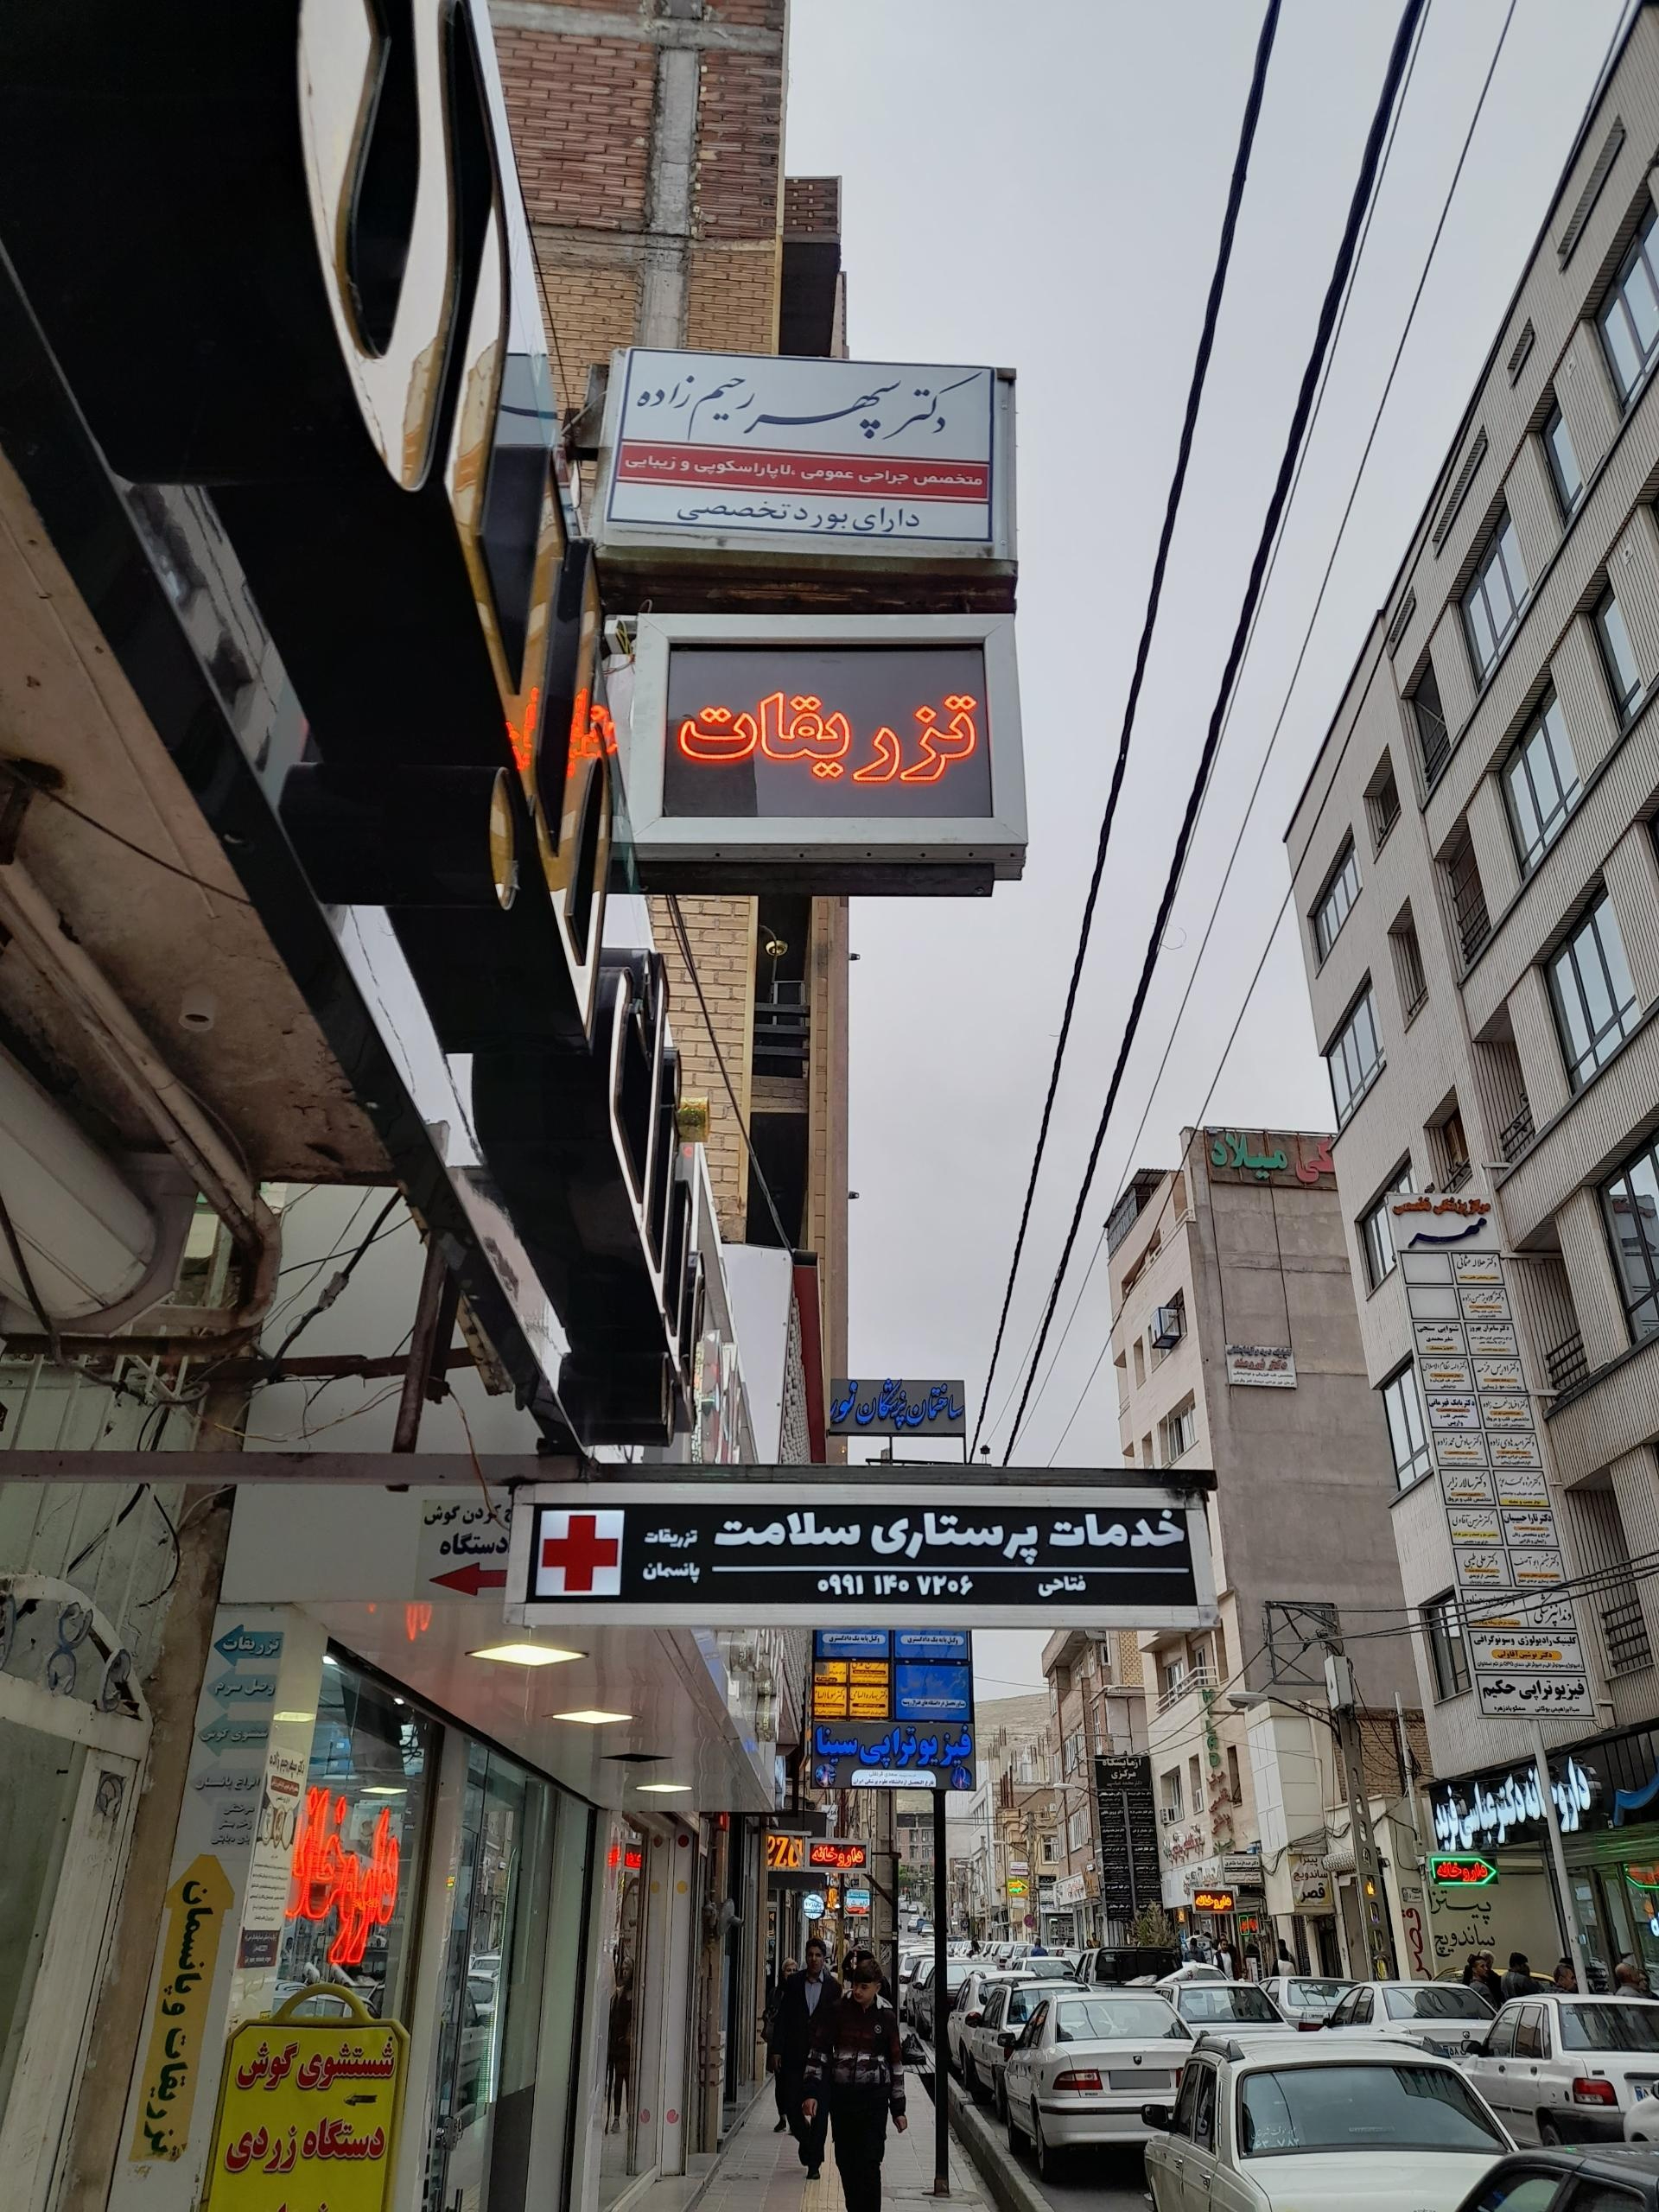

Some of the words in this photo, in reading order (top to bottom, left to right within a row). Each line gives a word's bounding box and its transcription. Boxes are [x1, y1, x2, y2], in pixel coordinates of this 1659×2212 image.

[636, 374, 696, 409] زاده
[743, 378, 902, 441] سپهر
[881, 372, 983, 441] دکتر
[624, 454, 677, 471] زیبایی
[679, 459, 691, 473] و
[800, 464, 855, 482] عمومی
[858, 468, 910, 486] جراحی
[912, 472, 984, 488] متخصص
[677, 499, 791, 522] تخصصی
[794, 504, 849, 531] بورد
[852, 506, 921, 533] دارای
[678, 691, 978, 783] تزریقات
[1211, 1133, 1288, 1180] میلاد
[1472, 1472, 1487, 1491] دکتر
[714, 1512, 861, 1548] سلامت
[1048, 1508, 1187, 1551] خدمات
[1539, 1514, 1553, 1524] دکتر
[644, 1529, 698, 1547] تزریقات
[872, 1512, 1039, 1565] پرستاری
[642, 1562, 700, 1582] پانسمان
[1038, 1574, 1087, 1598] فتاحی
[221, 1635, 281, 1656] تزریقات
[1553, 1636, 1576, 1647] کلینیک
[1482, 1679, 1516, 1700] حکیم
[1519, 1679, 1586, 1701] فیزیوتراپی
[815, 1725, 859, 1765] سینا
[859, 1724, 973, 1769] فیزیوتراپی
[1111, 1769, 1137, 1780] مرکزی
[811, 1846, 864, 1866] داروخانه
[1436, 1860, 1488, 1883] داروخانه
[1195, 1894, 1232, 1910] داروخانه
[1300, 1882, 1326, 1904] قصر
[1427, 1888, 1492, 1926] پیتزا
[1433, 1923, 1496, 1958] ساندویچ
[235, 2041, 299, 2091] گوش
[296, 2033, 397, 2091] شستشوی
[225, 2122, 299, 2174] زردی
[301, 2114, 387, 2162] دستگاه
